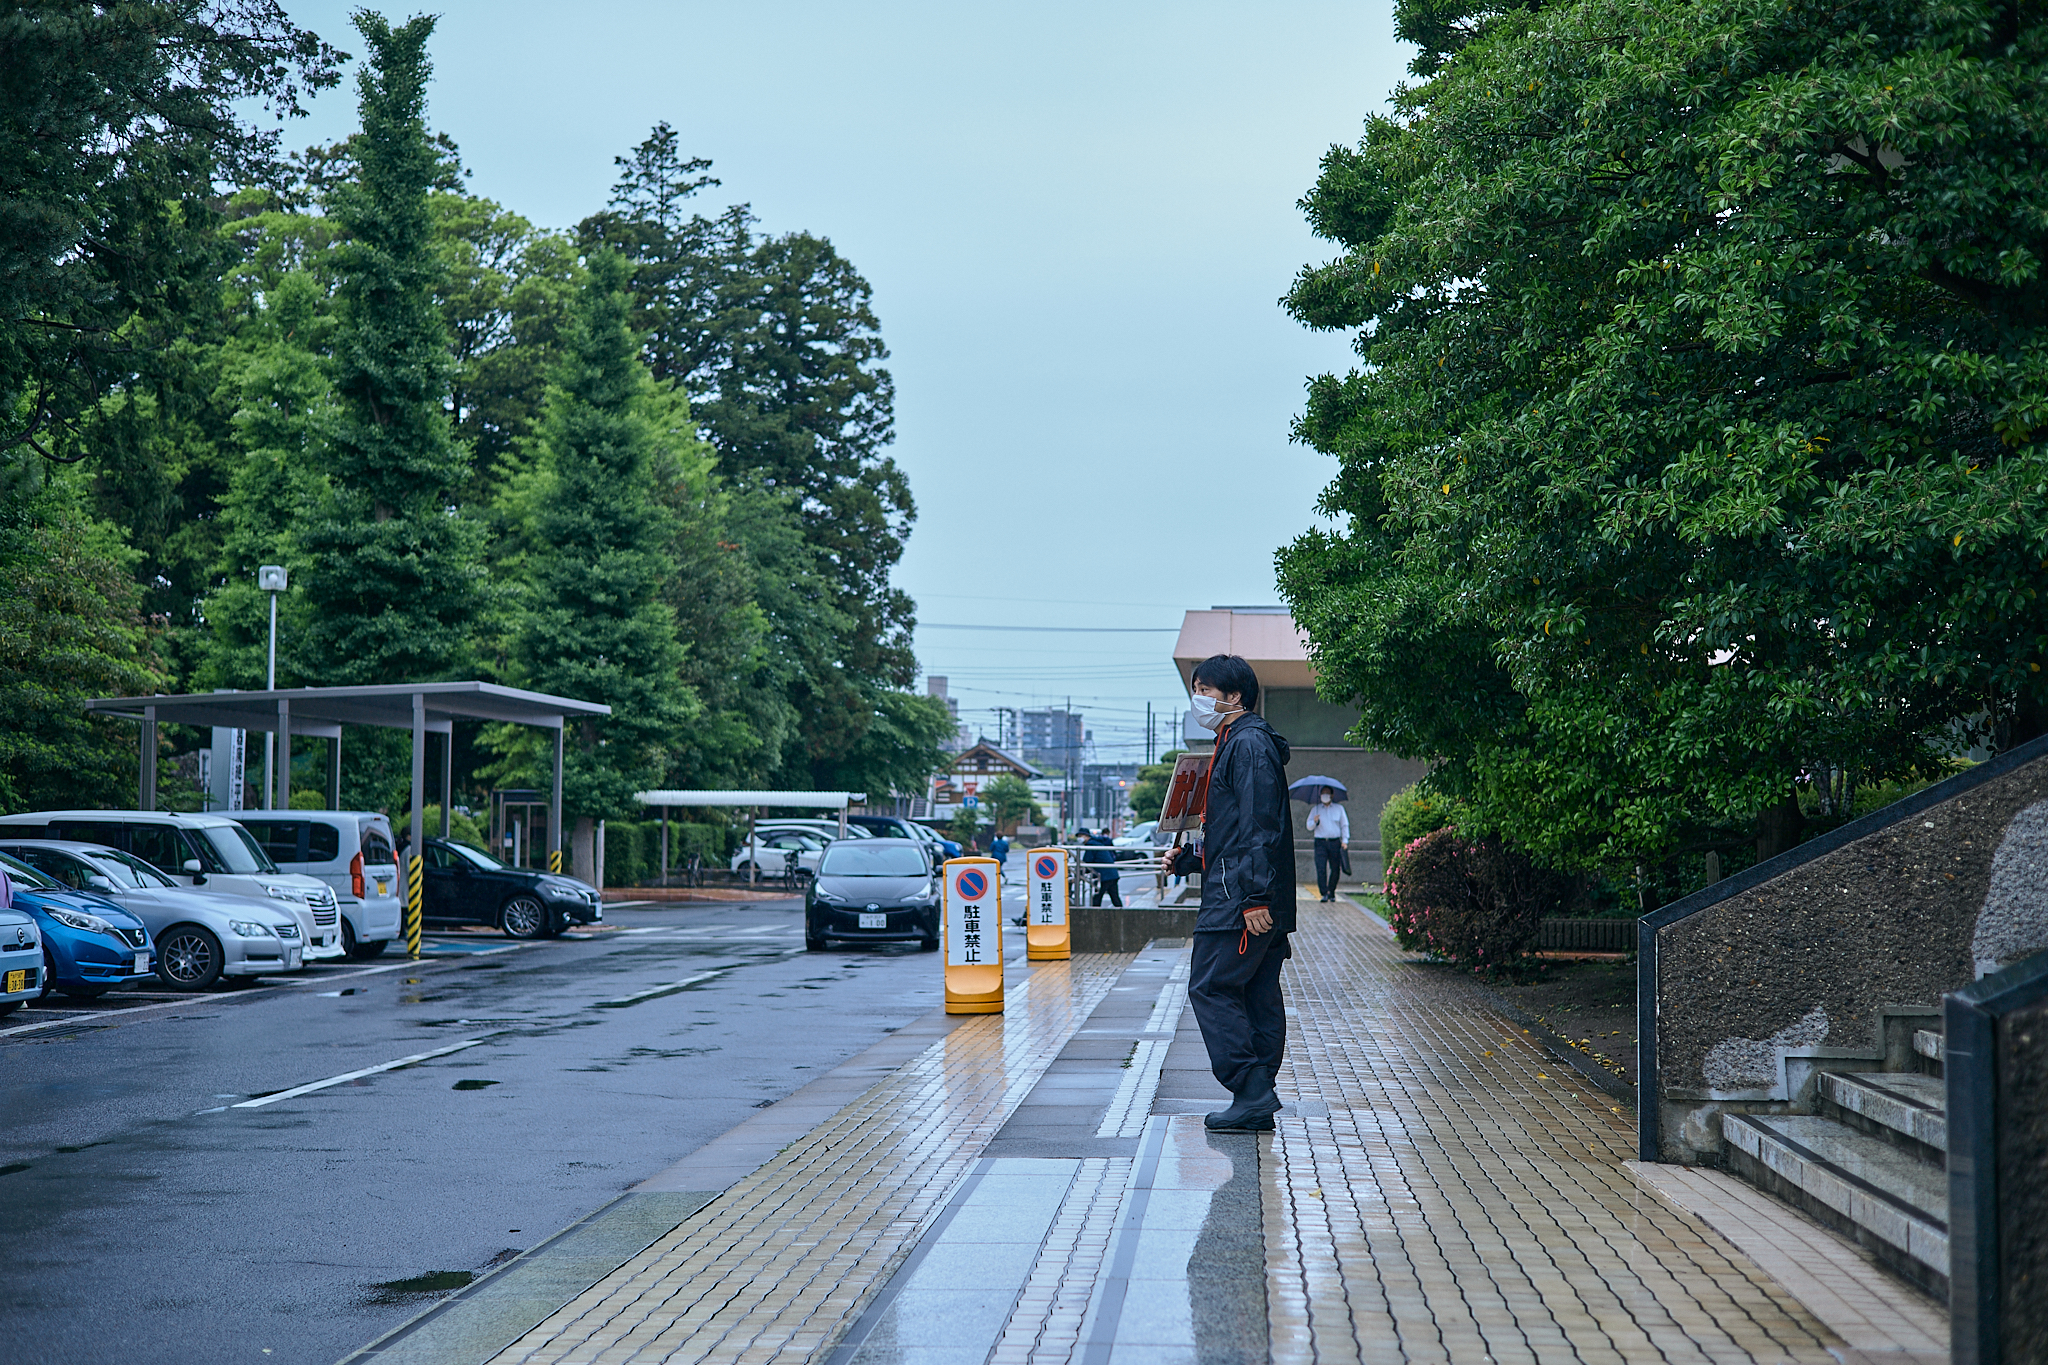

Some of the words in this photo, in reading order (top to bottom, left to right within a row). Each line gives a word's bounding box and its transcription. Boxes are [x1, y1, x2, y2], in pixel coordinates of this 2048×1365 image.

[1041, 882, 1053, 923] 駐車禁止
[964, 905, 981, 963] 駐車禁止
